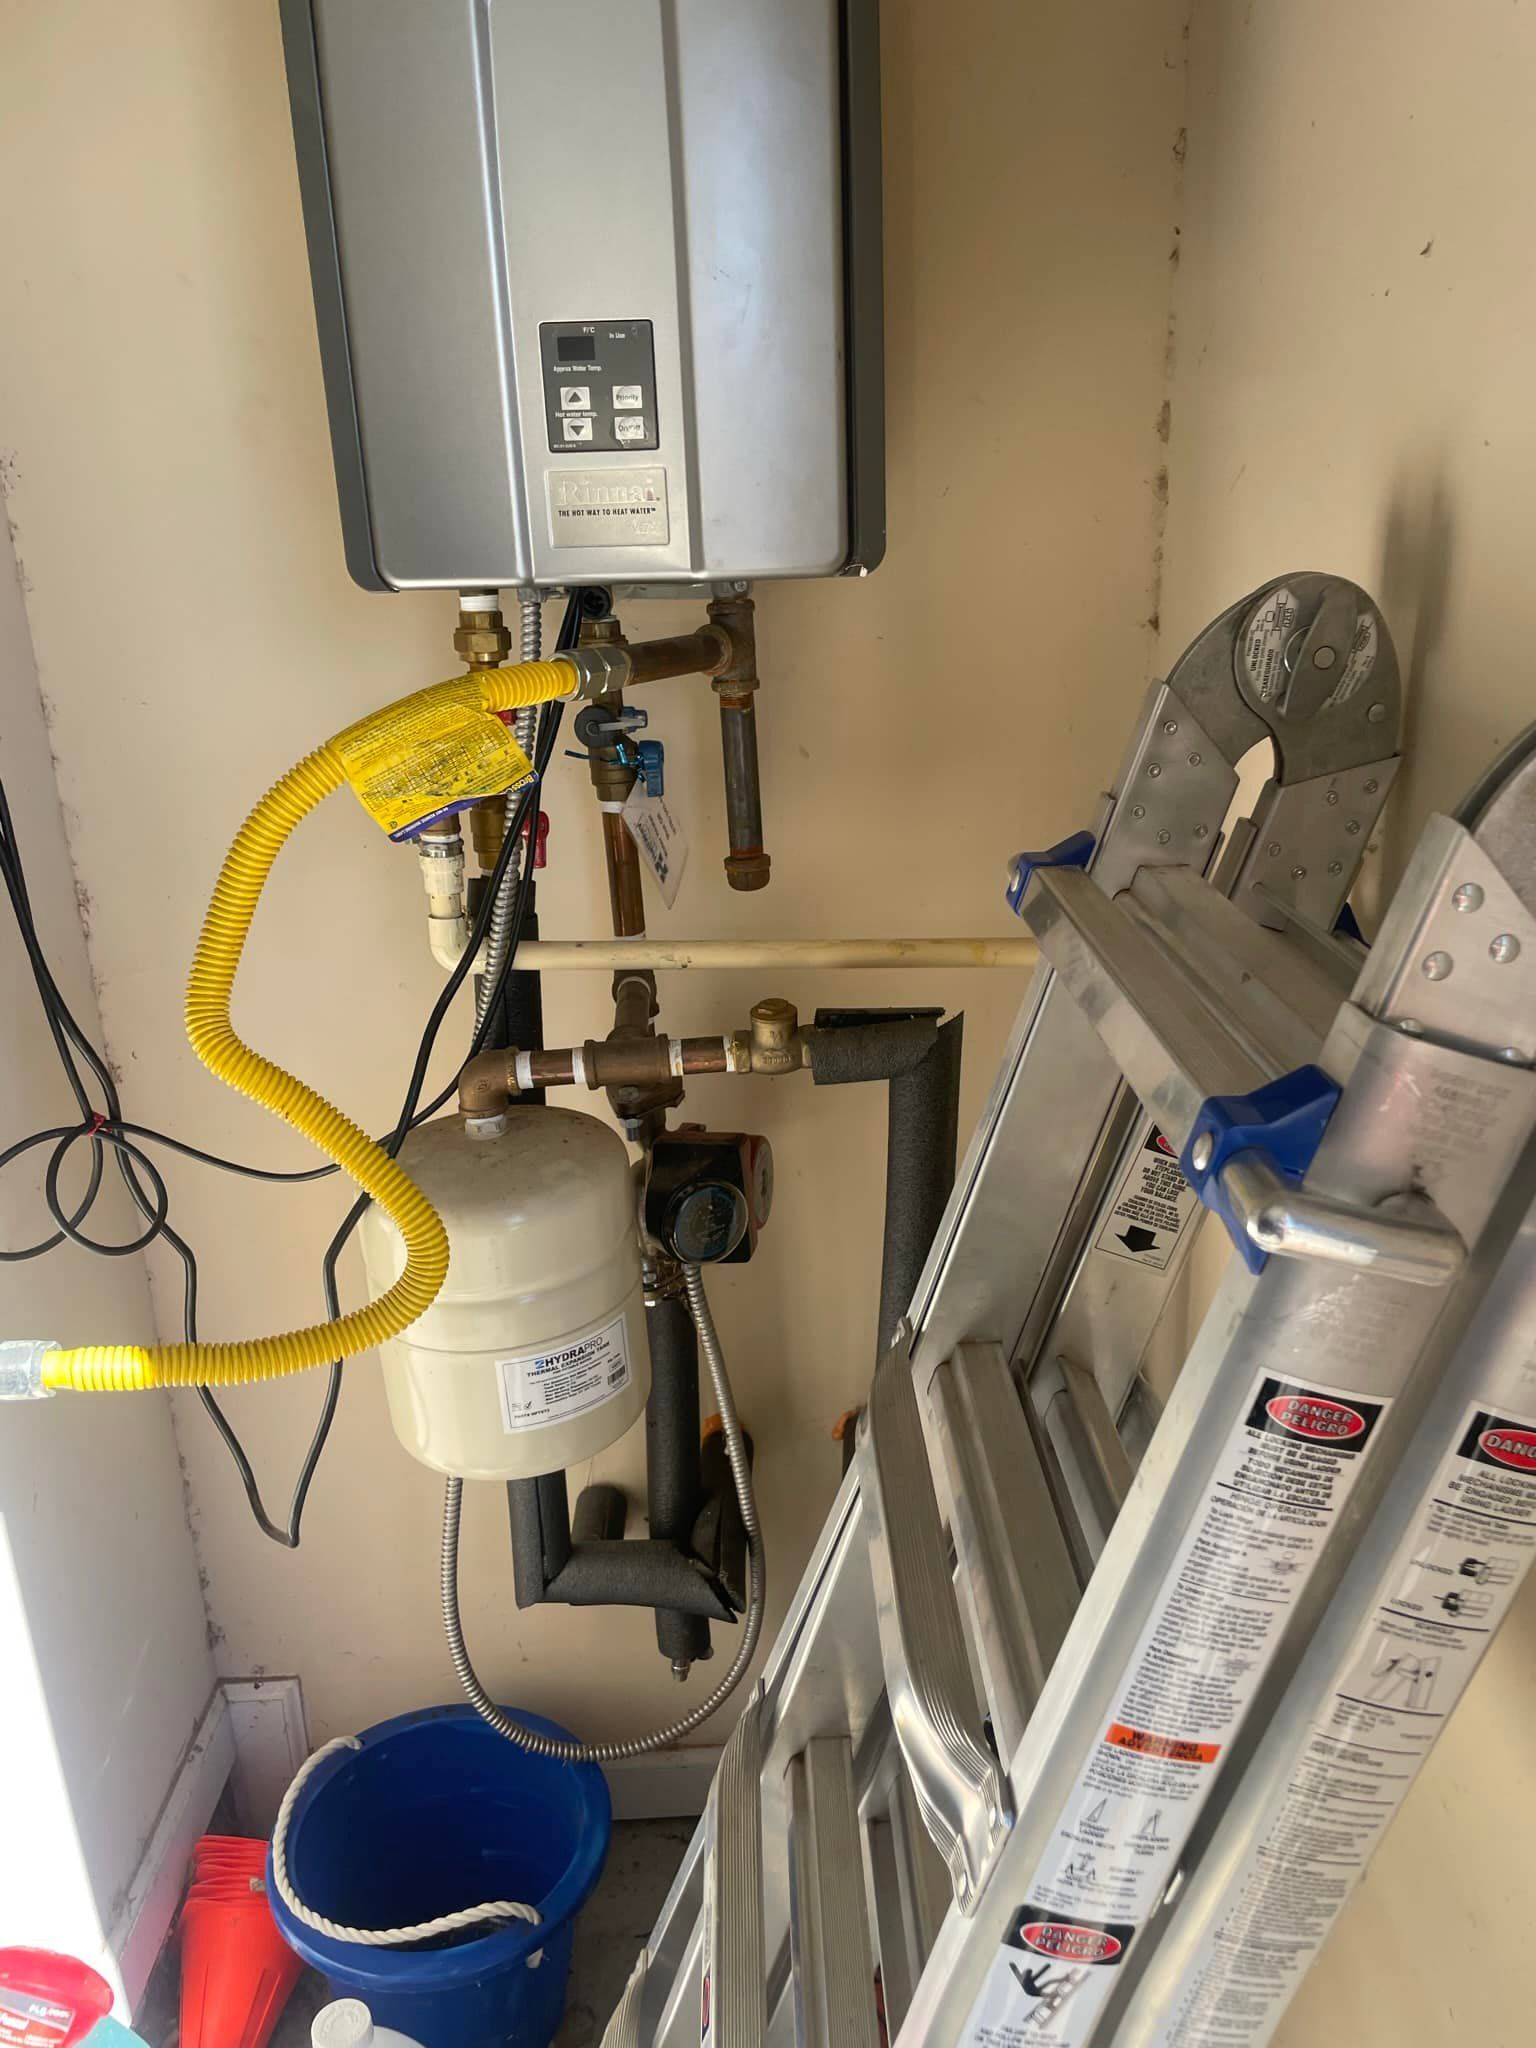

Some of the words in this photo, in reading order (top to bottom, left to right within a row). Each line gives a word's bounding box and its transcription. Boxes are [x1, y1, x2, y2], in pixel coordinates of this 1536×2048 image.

[1250, 638, 1262, 672] UNLOCKED
[527, 1365, 559, 1378] THERMAL
[561, 1349, 595, 1369] EXPANSION
[596, 1341, 610, 1352] TANK
[545, 1336, 603, 1368] HYDRAPRO
[1289, 1400, 1352, 1422] DANGER
[1281, 1412, 1348, 1436] PELIGRO
[1246, 1430, 1261, 1439] ALL
[1265, 1435, 1302, 1450] LOCKING
[1249, 1448, 1281, 1461] BEFORE
[1284, 1458, 1309, 1468] USING
[1312, 1464, 1341, 1474] LADDER
[1261, 1444, 1284, 1454] MUST
[1300, 1453, 1337, 1465] ENGAGED
[1249, 1458, 1271, 1469] TODO
[1275, 1466, 1321, 1481] MECANISMO
[1479, 1469, 1498, 1482] ALL
[1448, 1481, 1462, 1491] BE
[1465, 1485, 1513, 1505] ENGAGED
[1461, 1495, 1492, 1510] USING
[1265, 1500, 1317, 1518] OPERATION
[1043, 1926, 1107, 1946] DANGER
[1034, 1938, 1104, 1960] PELIGRO
